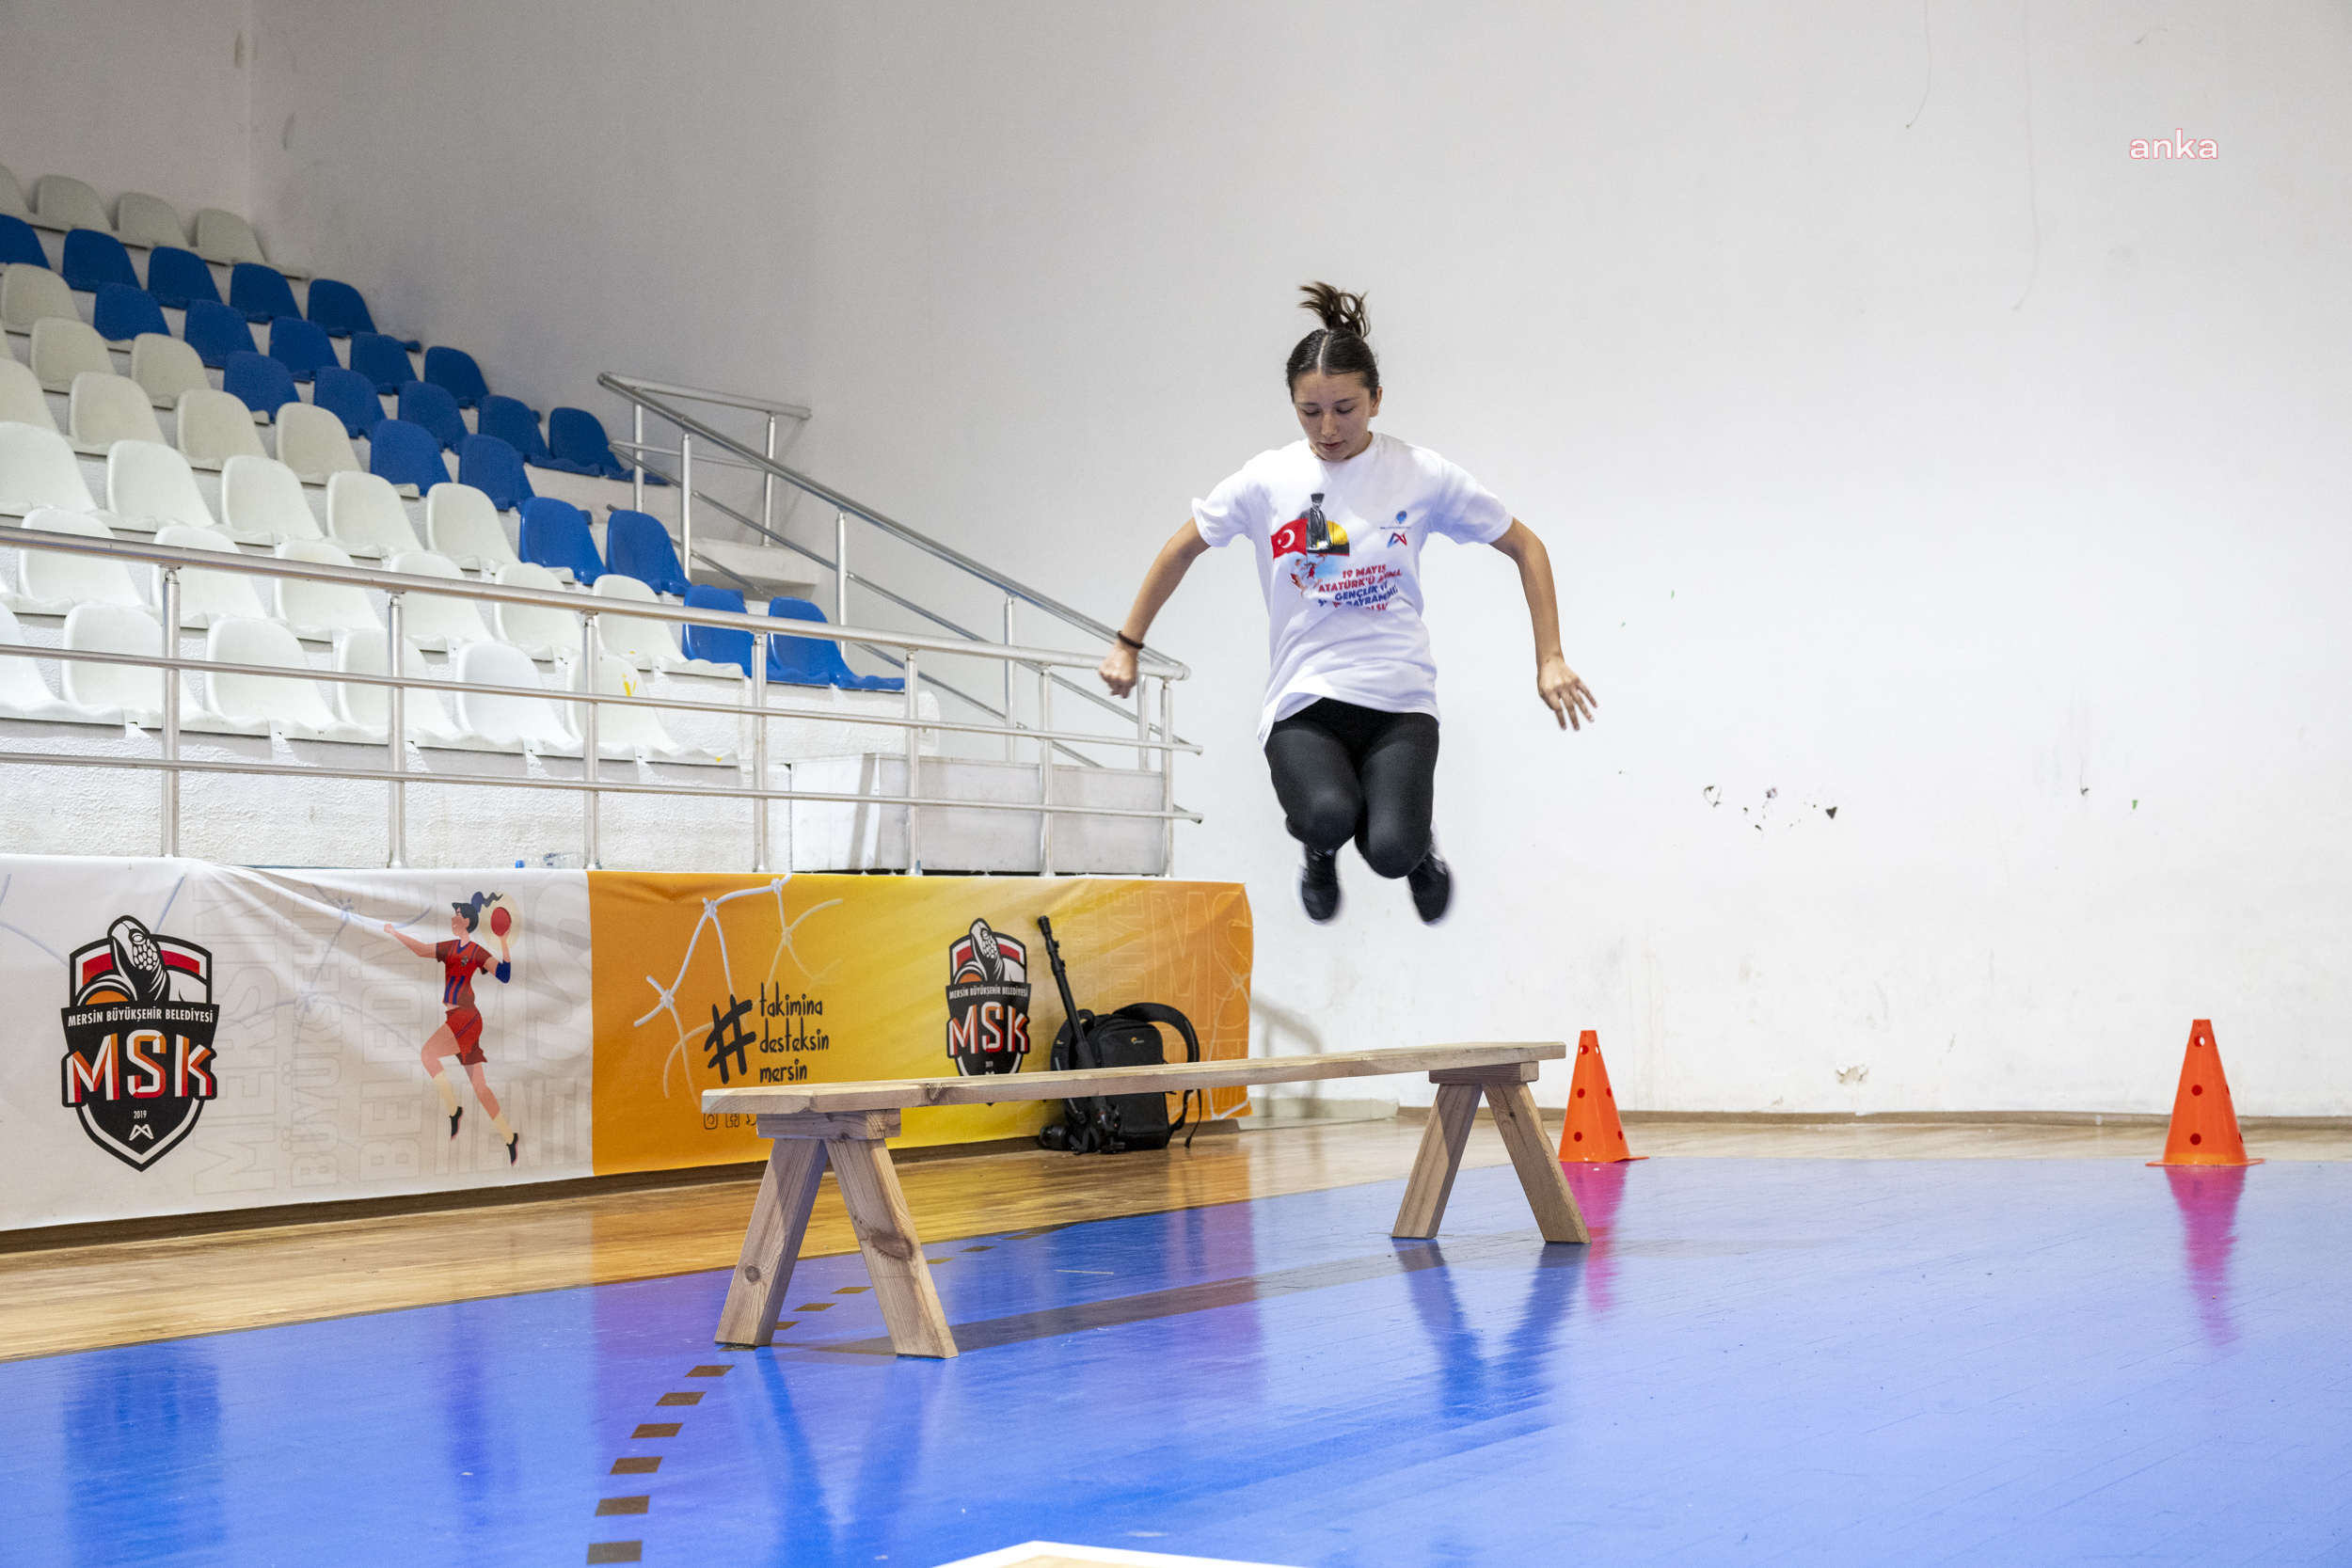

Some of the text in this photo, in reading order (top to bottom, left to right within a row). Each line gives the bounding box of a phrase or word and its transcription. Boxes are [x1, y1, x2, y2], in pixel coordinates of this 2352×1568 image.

[1343, 569, 1353, 578] 19
[759, 981, 823, 1017] takimina
[68, 1006, 214, 1027] MERSİN BÜYÜKŞEHİR BELEDİYESİ
[948, 1001, 1028, 1056] MSK
[759, 1016, 829, 1053] desteksin
[67, 1029, 213, 1104] MSK
[759, 1058, 807, 1083] mersin
[133, 1110, 148, 1119] 2019
